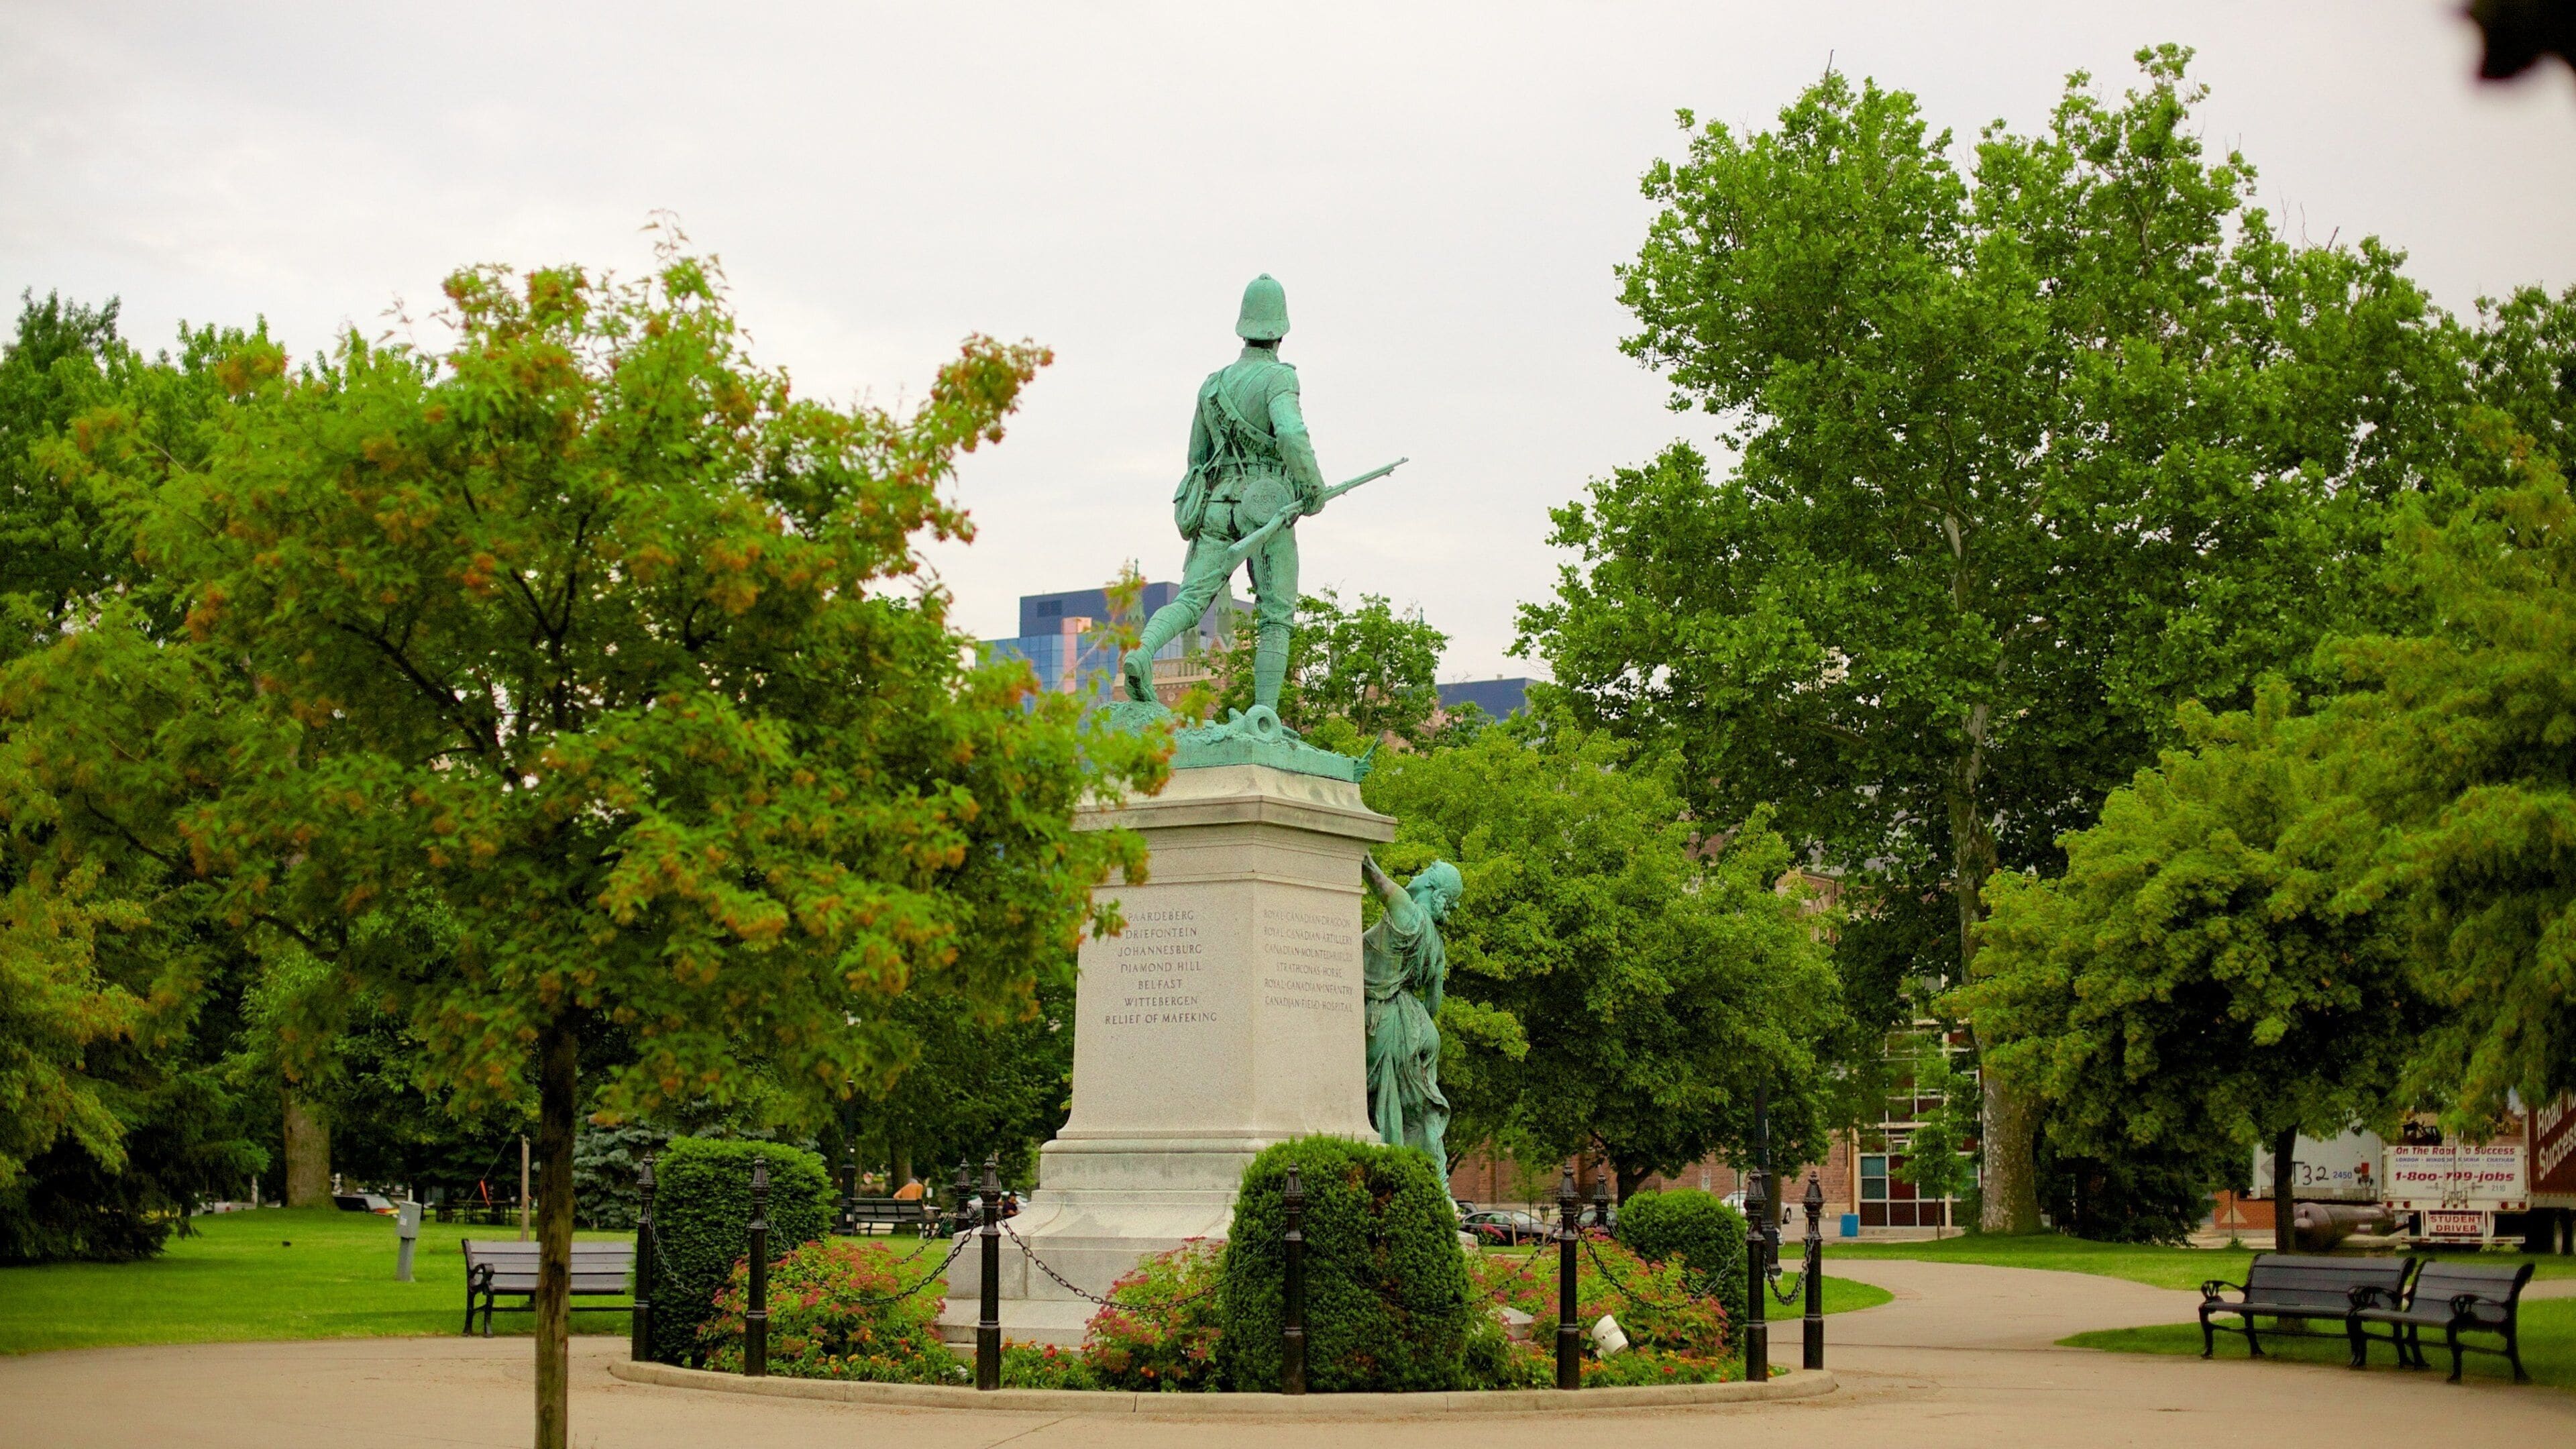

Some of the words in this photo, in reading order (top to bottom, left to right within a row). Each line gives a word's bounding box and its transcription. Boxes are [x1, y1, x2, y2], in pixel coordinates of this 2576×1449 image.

[1128, 910, 1194, 922] PAARDEBERG
[1126, 927, 1197, 939] DRIEFONTEIN
[1118, 944, 1202, 957] JOHANNESBURG
[1121, 961, 1172, 973] DIAMOND
[1177, 961, 1201, 972] HILL
[1138, 979, 1182, 990] BELFAST
[1265, 978, 1285, 989] ROYAL
[1124, 996, 1197, 1007] WITTEBERGEN
[1265, 996, 1299, 1008] CANADIAN
[1106, 1014, 1140, 1024] RELIEF
[1145, 1014, 1158, 1024] OF
[1162, 1012, 1217, 1024] MAFEKING
[2396, 1146, 2409, 1155] On
[2412, 1146, 2428, 1155] The
[2474, 1146, 2515, 1155] Success
